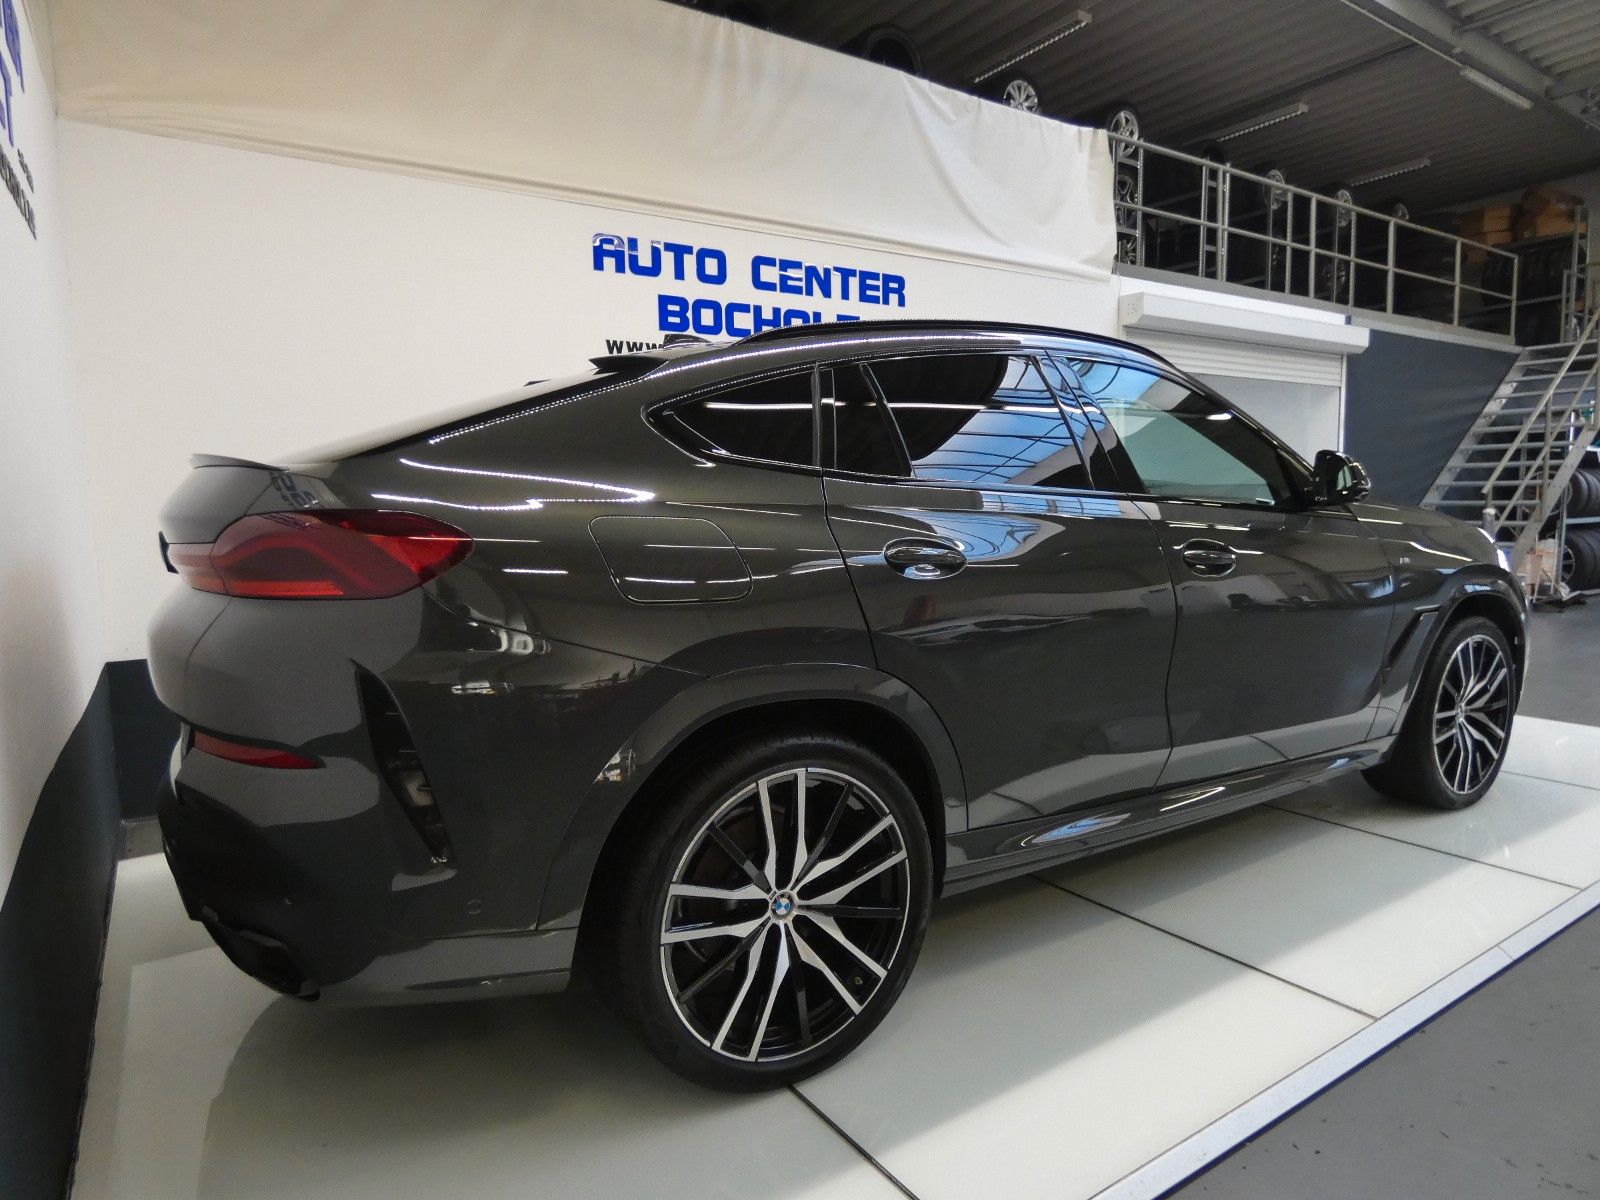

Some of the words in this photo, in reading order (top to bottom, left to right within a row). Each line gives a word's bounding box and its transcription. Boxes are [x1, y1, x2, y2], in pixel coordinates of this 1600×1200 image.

[593, 233, 727, 285] AUTO
[751, 255, 906, 308] CENTER
[658, 294, 860, 338] BOCH
